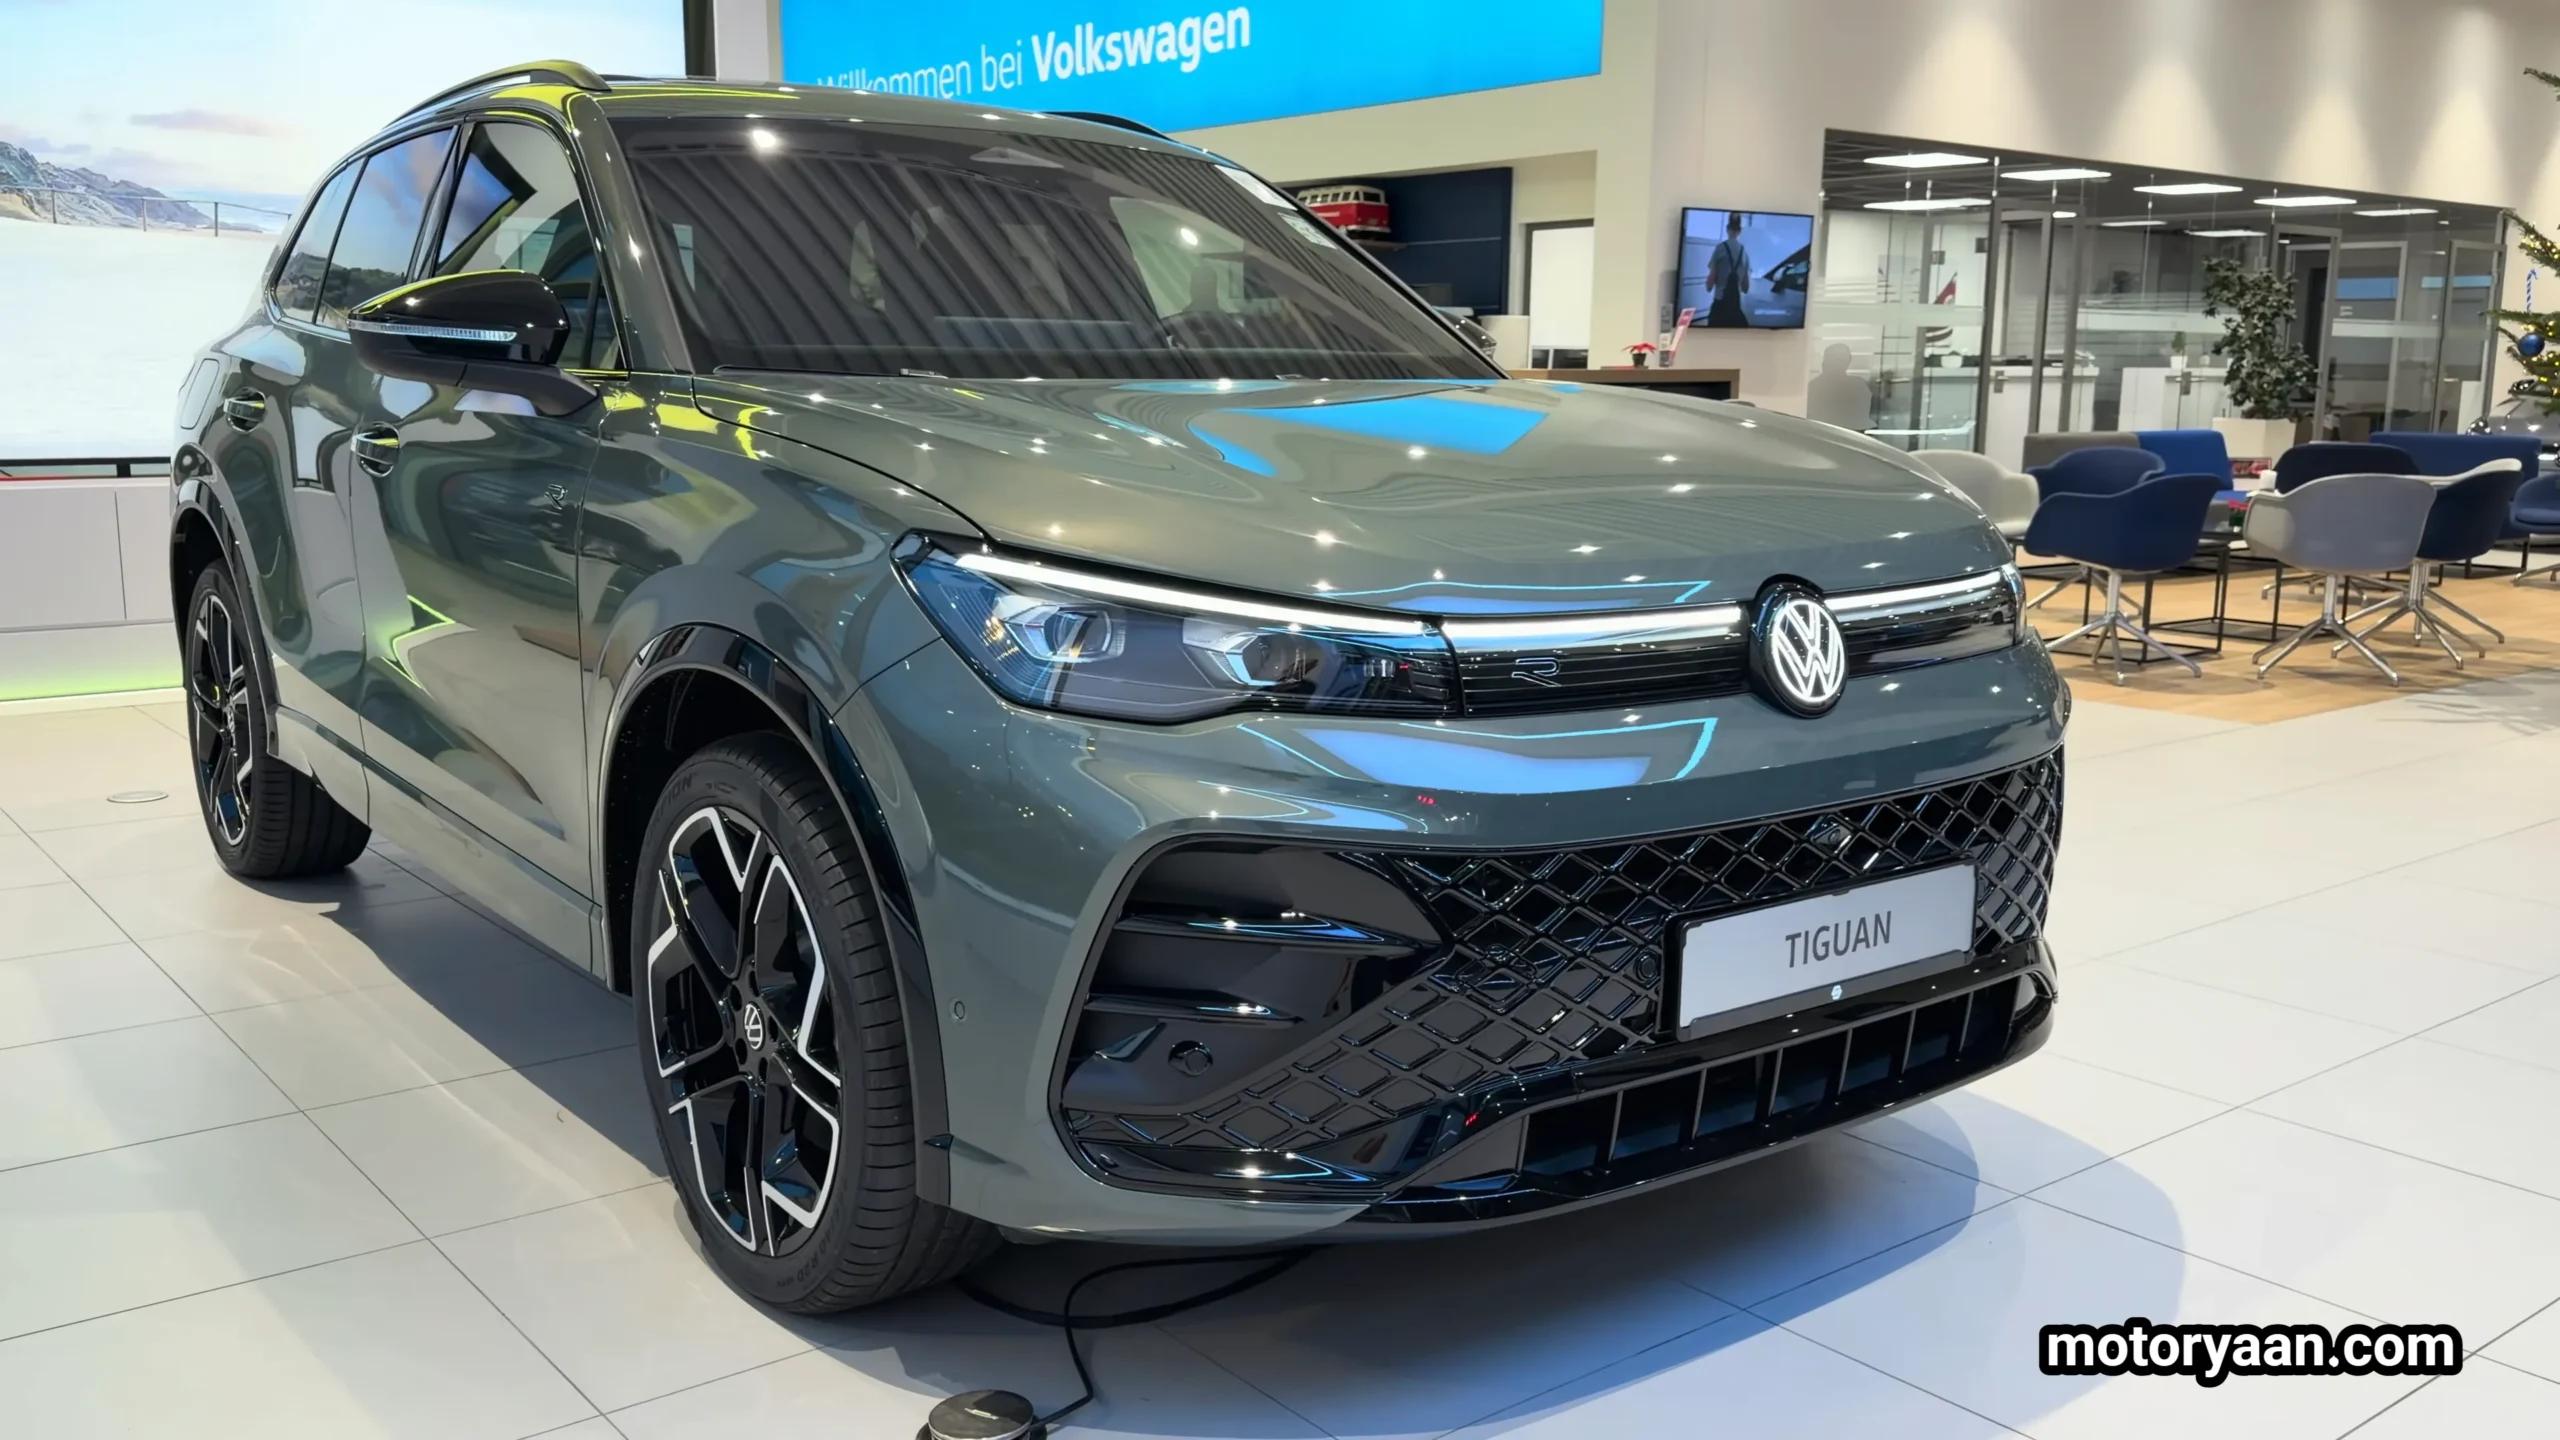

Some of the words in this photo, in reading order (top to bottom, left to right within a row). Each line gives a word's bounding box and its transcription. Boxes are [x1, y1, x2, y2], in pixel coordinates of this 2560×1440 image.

[816, 62, 972, 99] kommen
[981, 36, 1023, 92] bei
[1031, 5, 1251, 82] Volkswagen
[1785, 910, 1892, 969] TIGUAN
